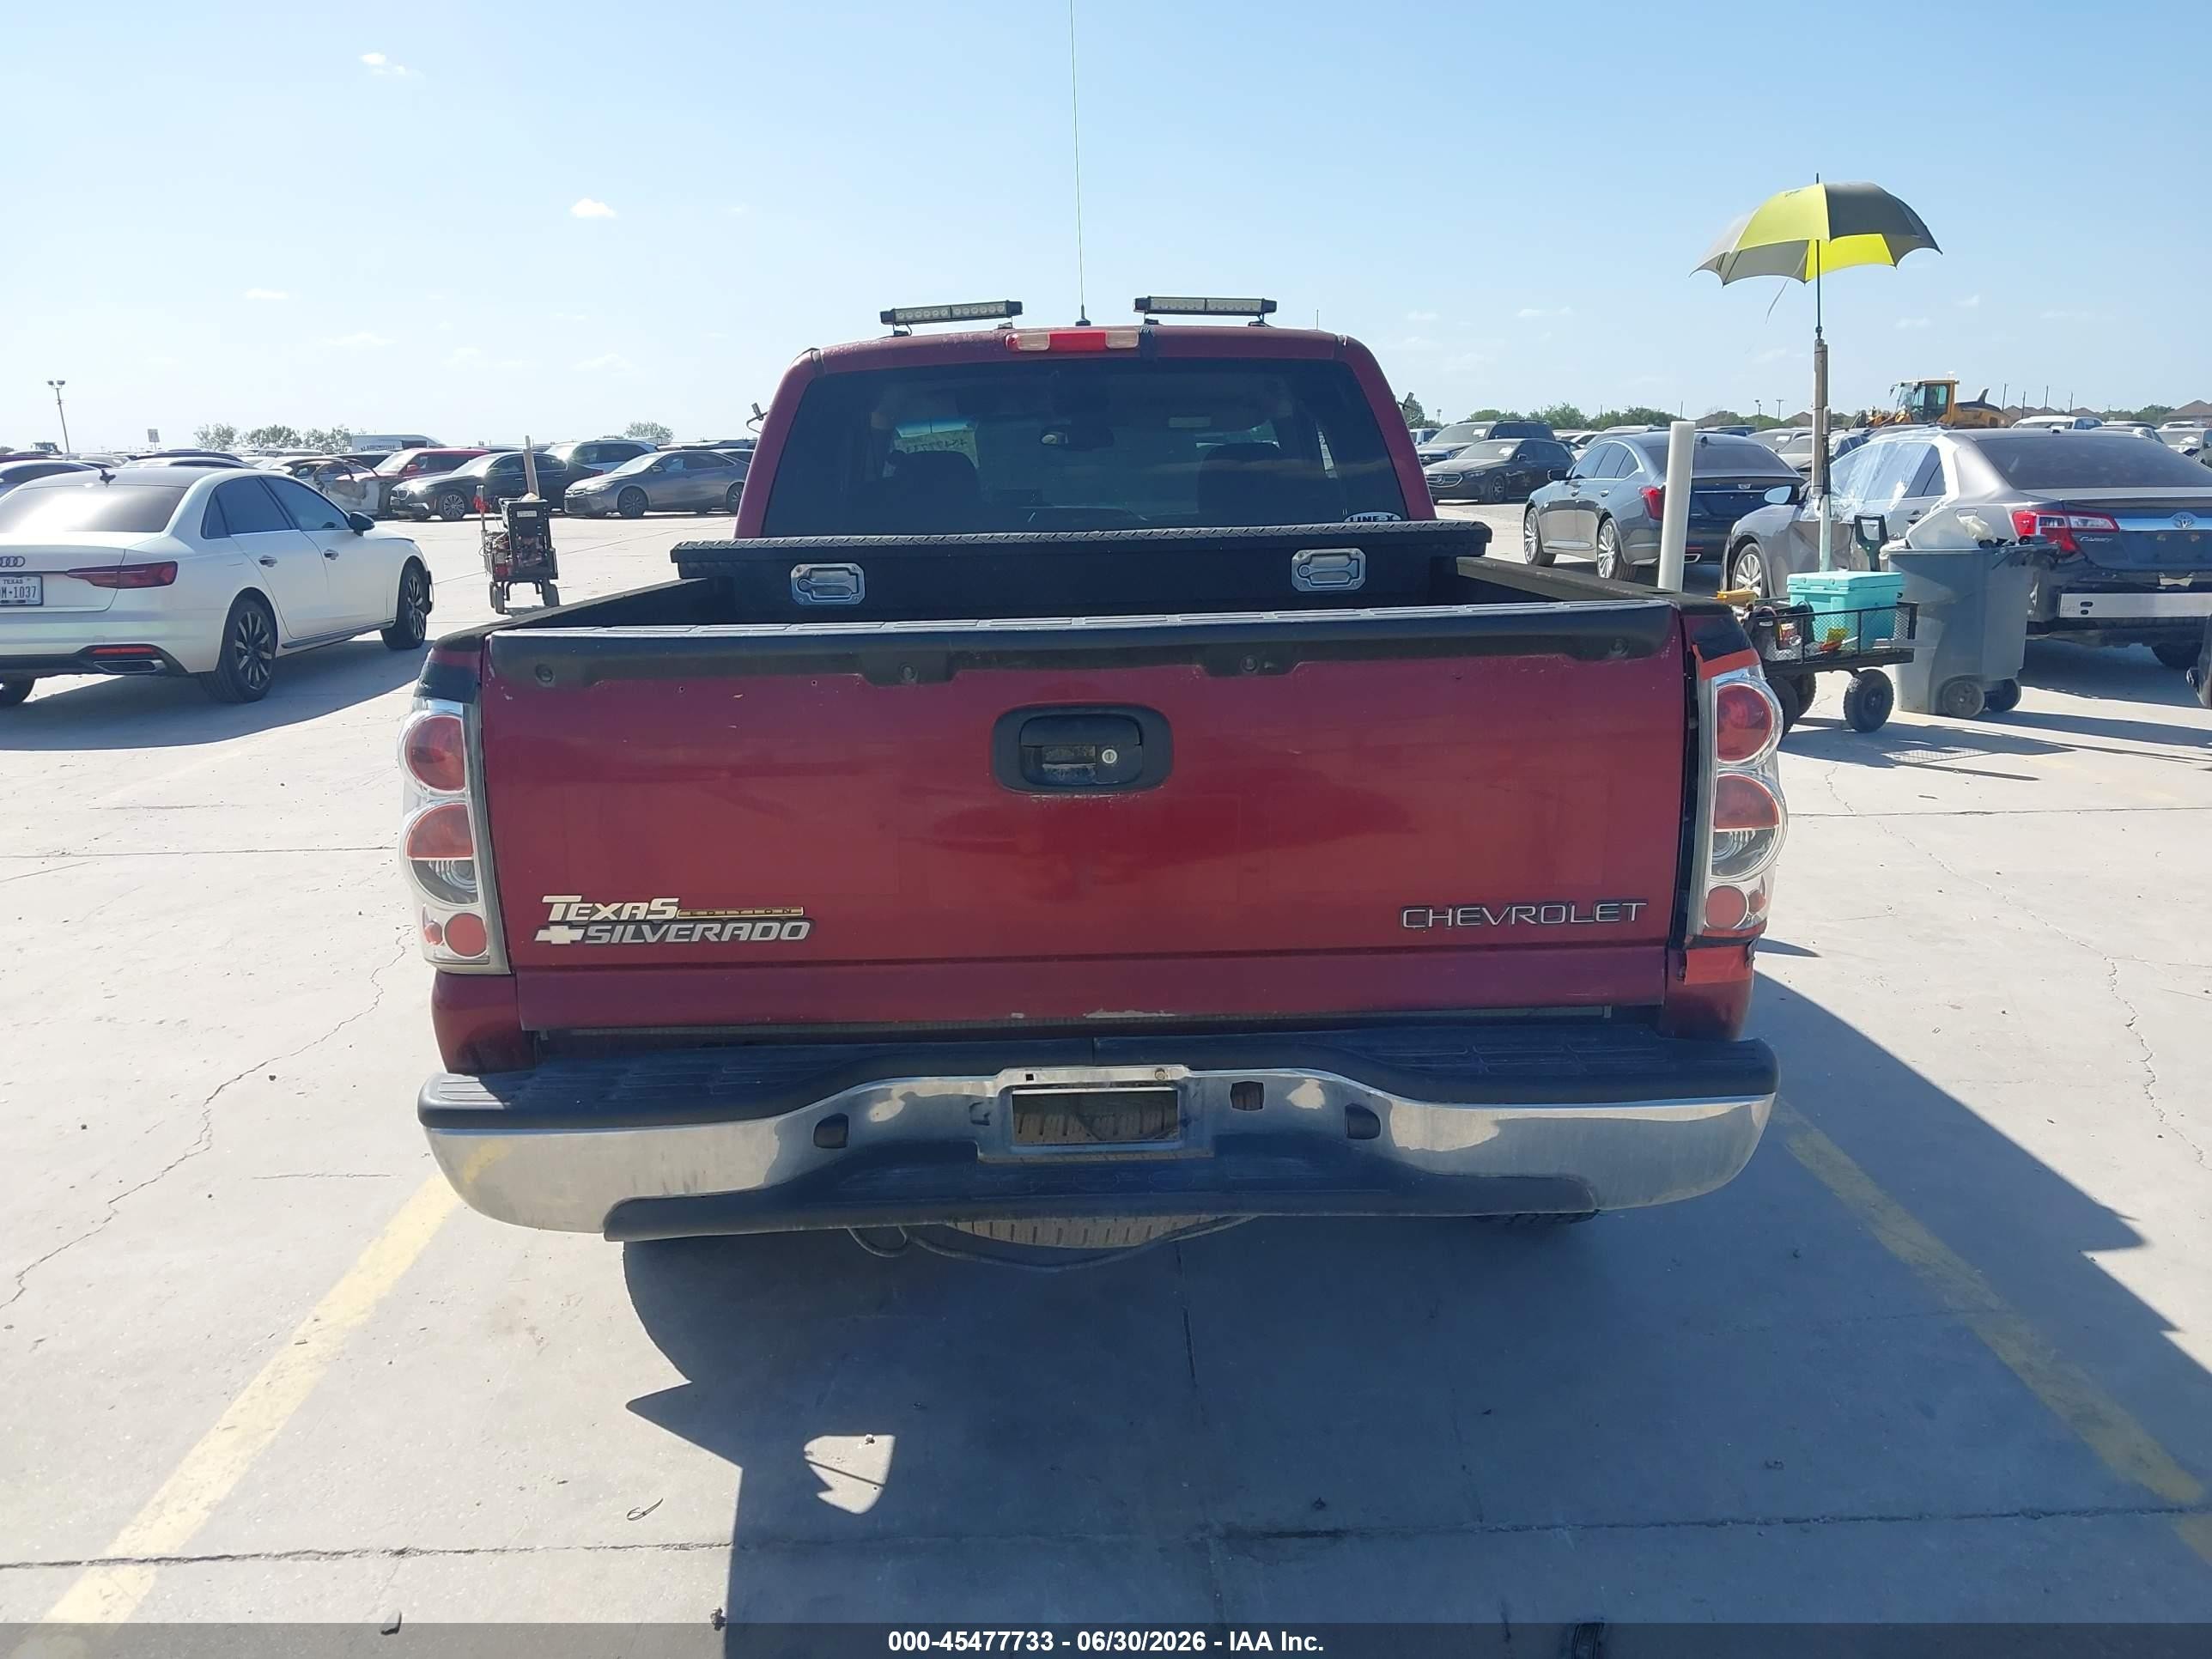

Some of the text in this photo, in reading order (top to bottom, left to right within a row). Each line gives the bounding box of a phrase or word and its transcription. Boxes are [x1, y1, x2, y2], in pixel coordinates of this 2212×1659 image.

[542, 895, 794, 921] TEXAS EDITION
[1401, 902, 1648, 928] CHEVROLET
[586, 921, 811, 944] SILVERADO
